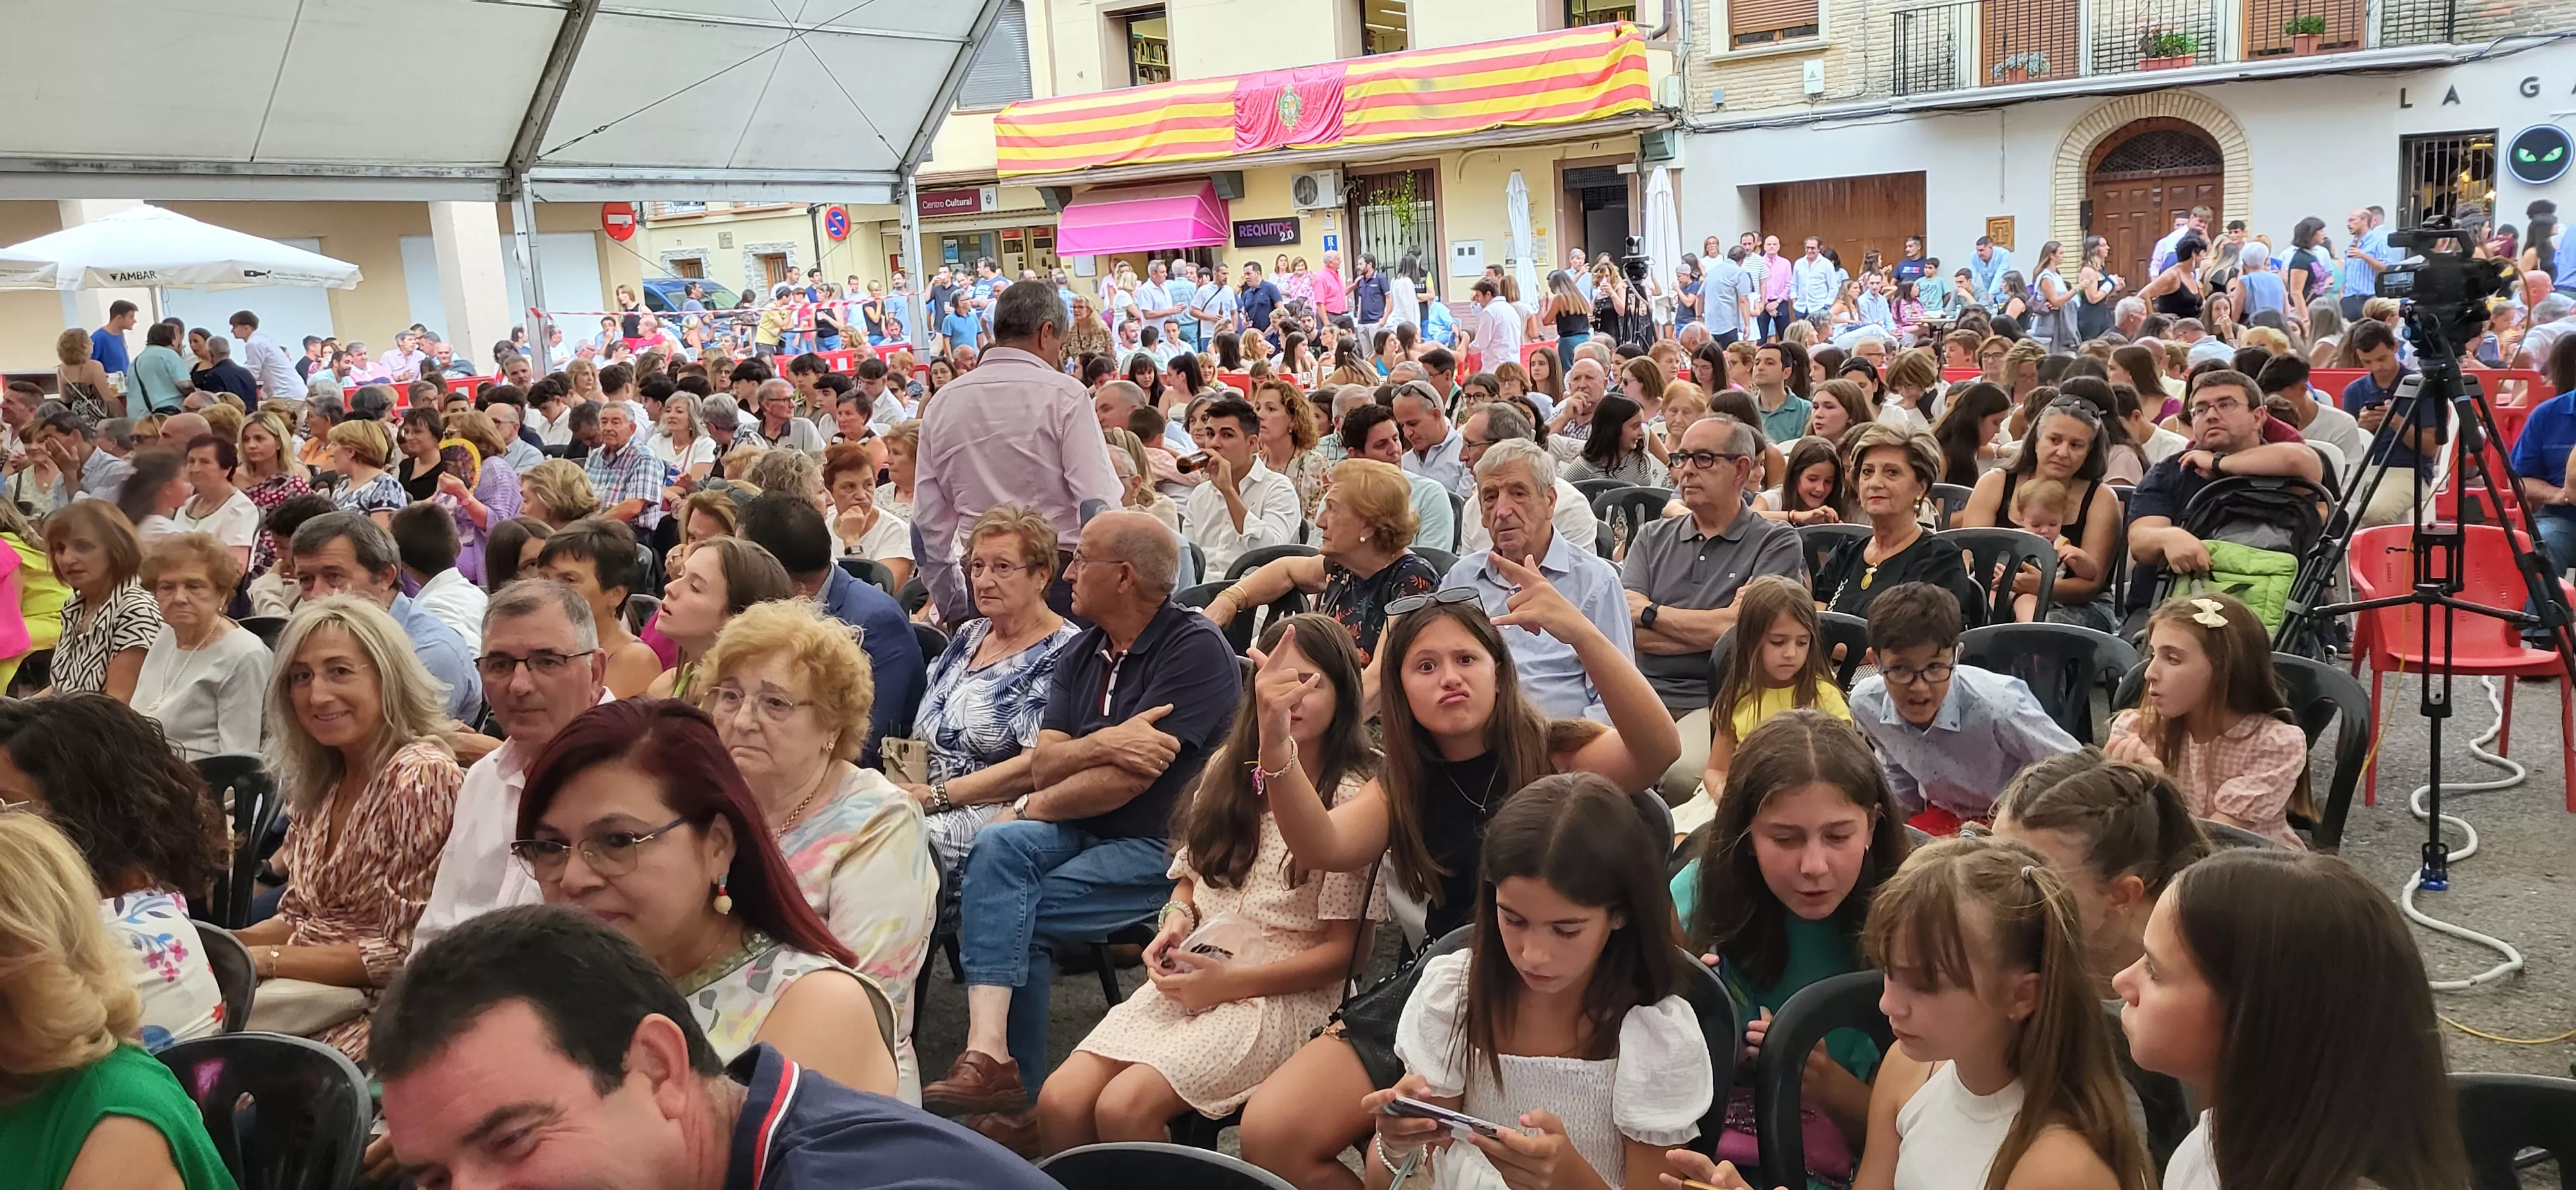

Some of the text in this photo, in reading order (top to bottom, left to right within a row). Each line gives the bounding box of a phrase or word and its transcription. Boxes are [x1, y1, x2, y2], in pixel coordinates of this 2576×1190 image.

[2400, 84, 2461, 108] LA
[922, 196, 972, 209] Centro Cultural
[1238, 221, 1293, 238] REQUITOS
[1279, 229, 1294, 242] 2.0
[1327, 236, 1334, 247] R
[119, 270, 157, 281] AMBAR
